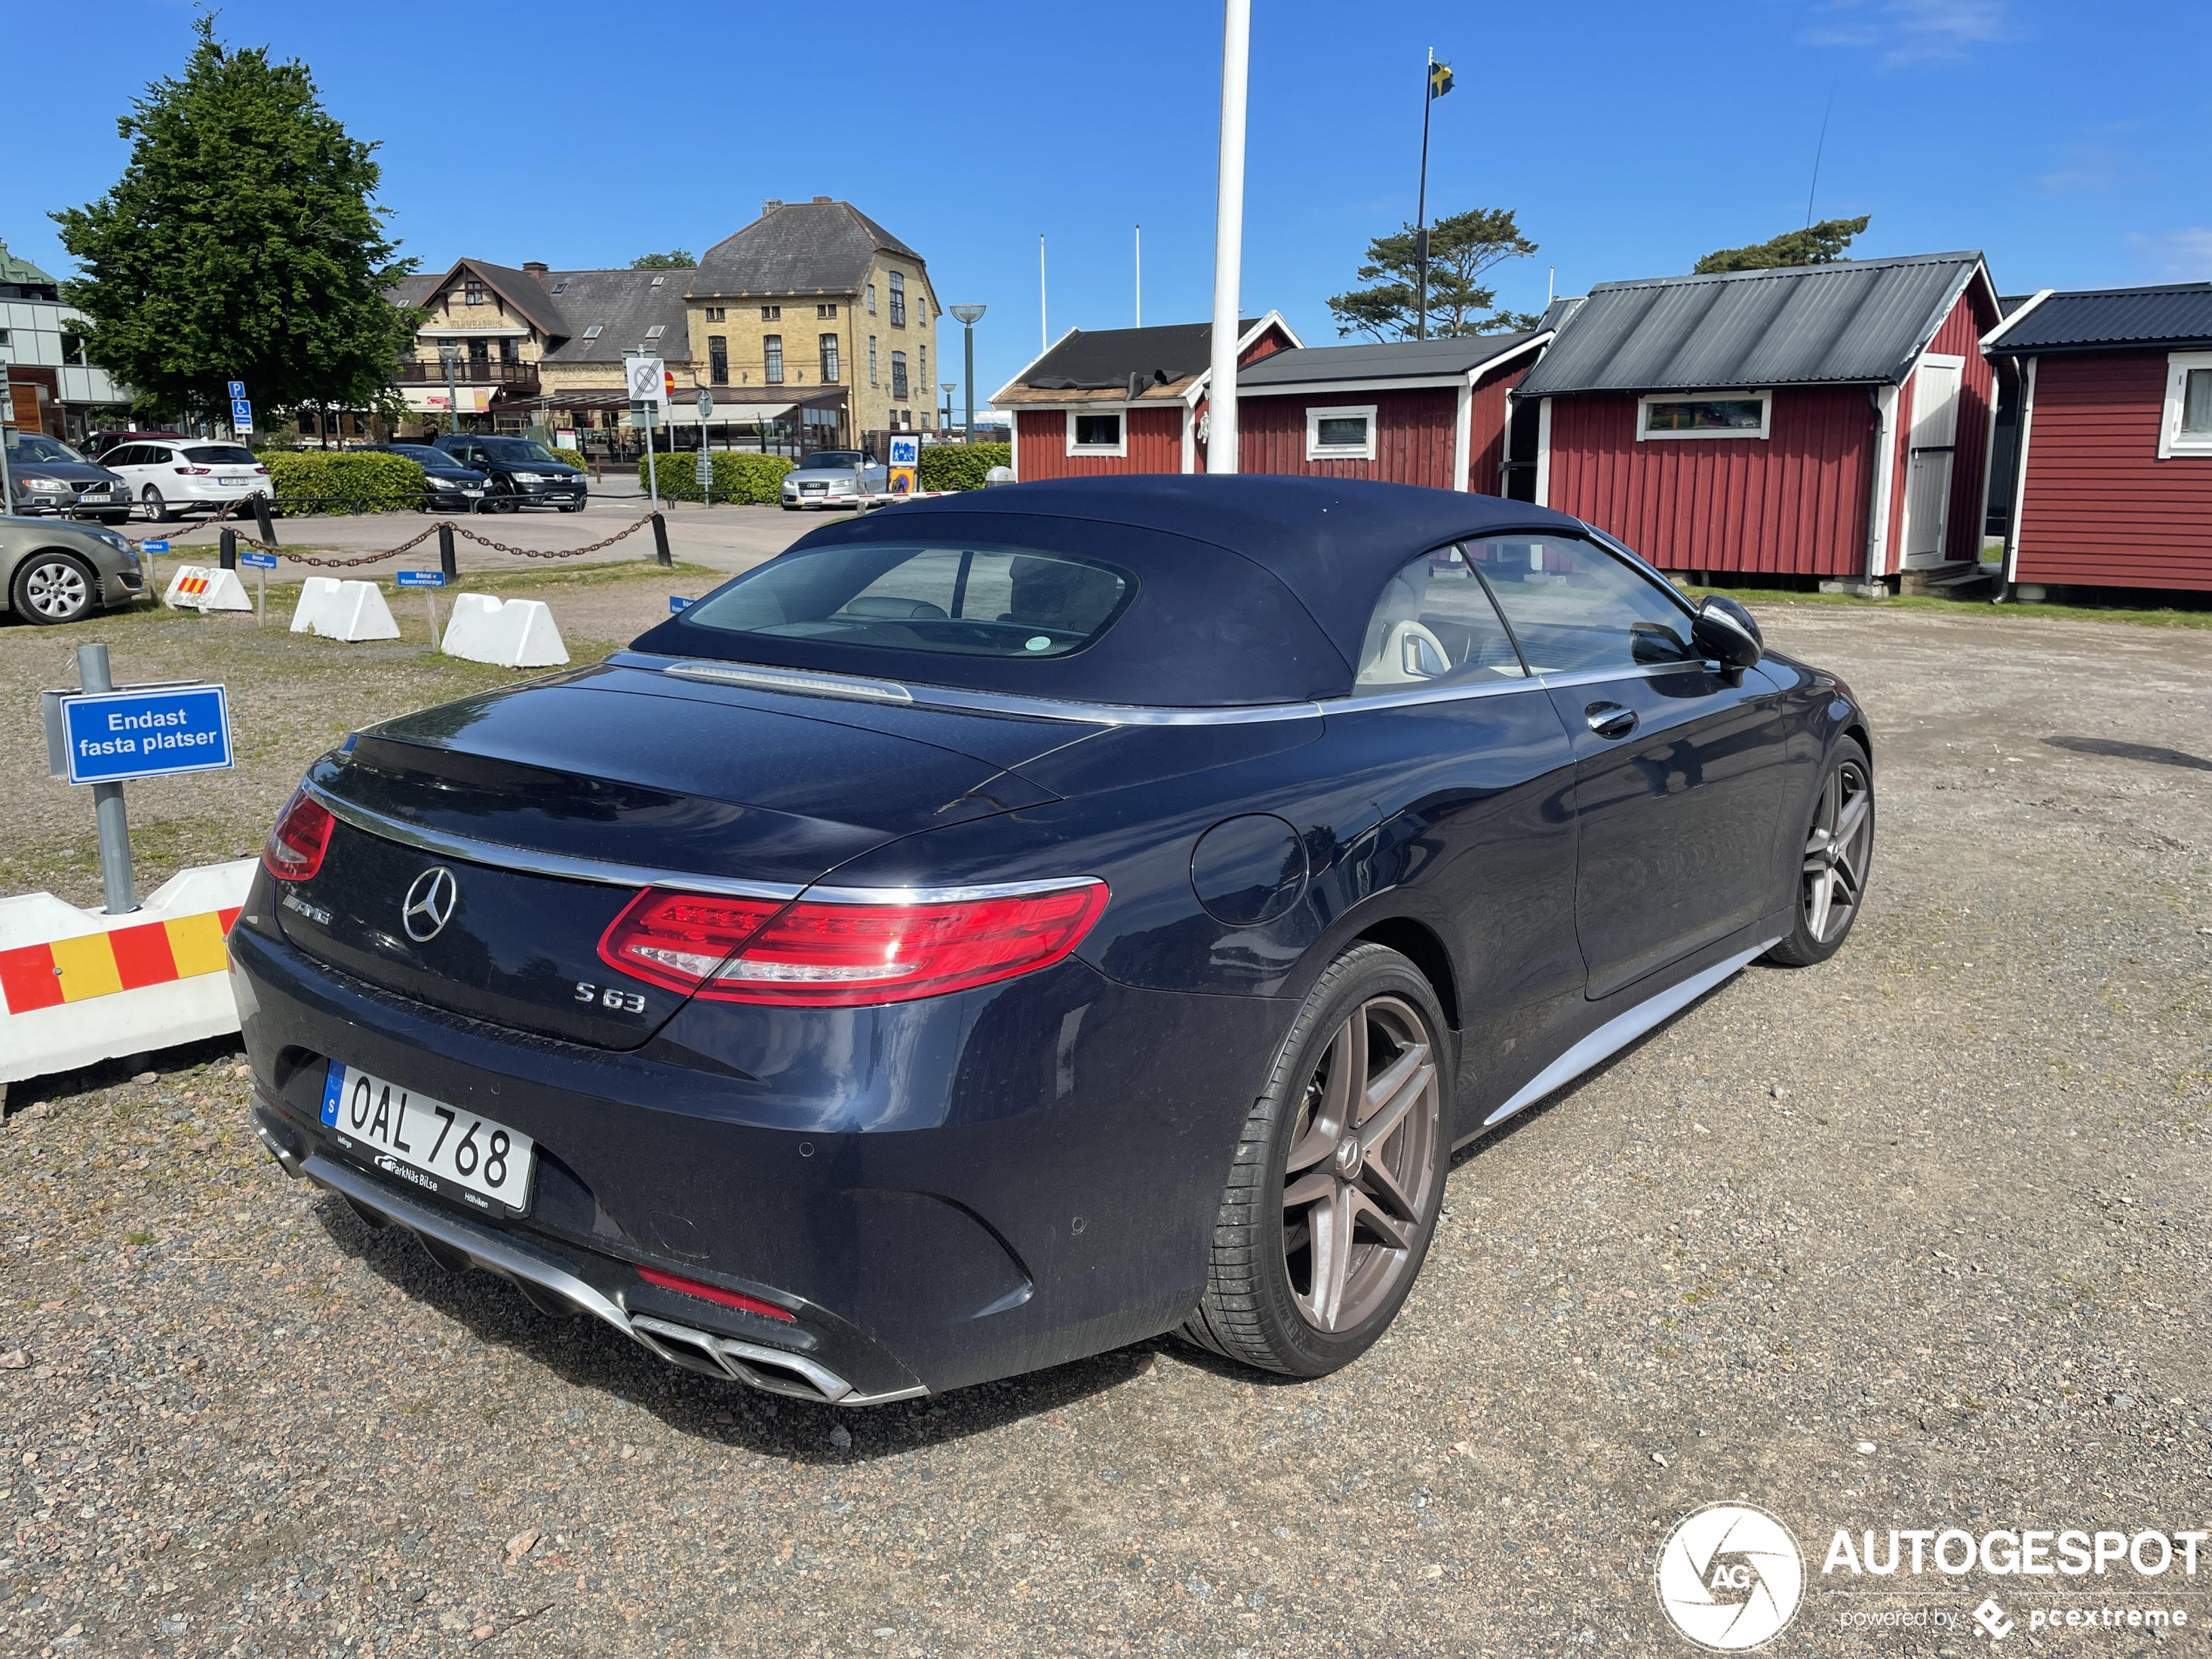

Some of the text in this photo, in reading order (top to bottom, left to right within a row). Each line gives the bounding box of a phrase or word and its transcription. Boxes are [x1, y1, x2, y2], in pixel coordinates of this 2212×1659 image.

[233, 383, 241, 395] P
[108, 708, 187, 732] Endast
[79, 731, 217, 757] fasta platser
[293, 900, 330, 925] AMG
[574, 981, 645, 1015] S 63
[327, 1098, 334, 1114] S
[337, 1135, 352, 1150] Vellinge
[350, 1076, 510, 1189] OAL 768
[390, 1161, 419, 1184] ParkNäs
[464, 1191, 489, 1209] Höllviken
[1267, 1245, 1291, 1322] MICHELIN
